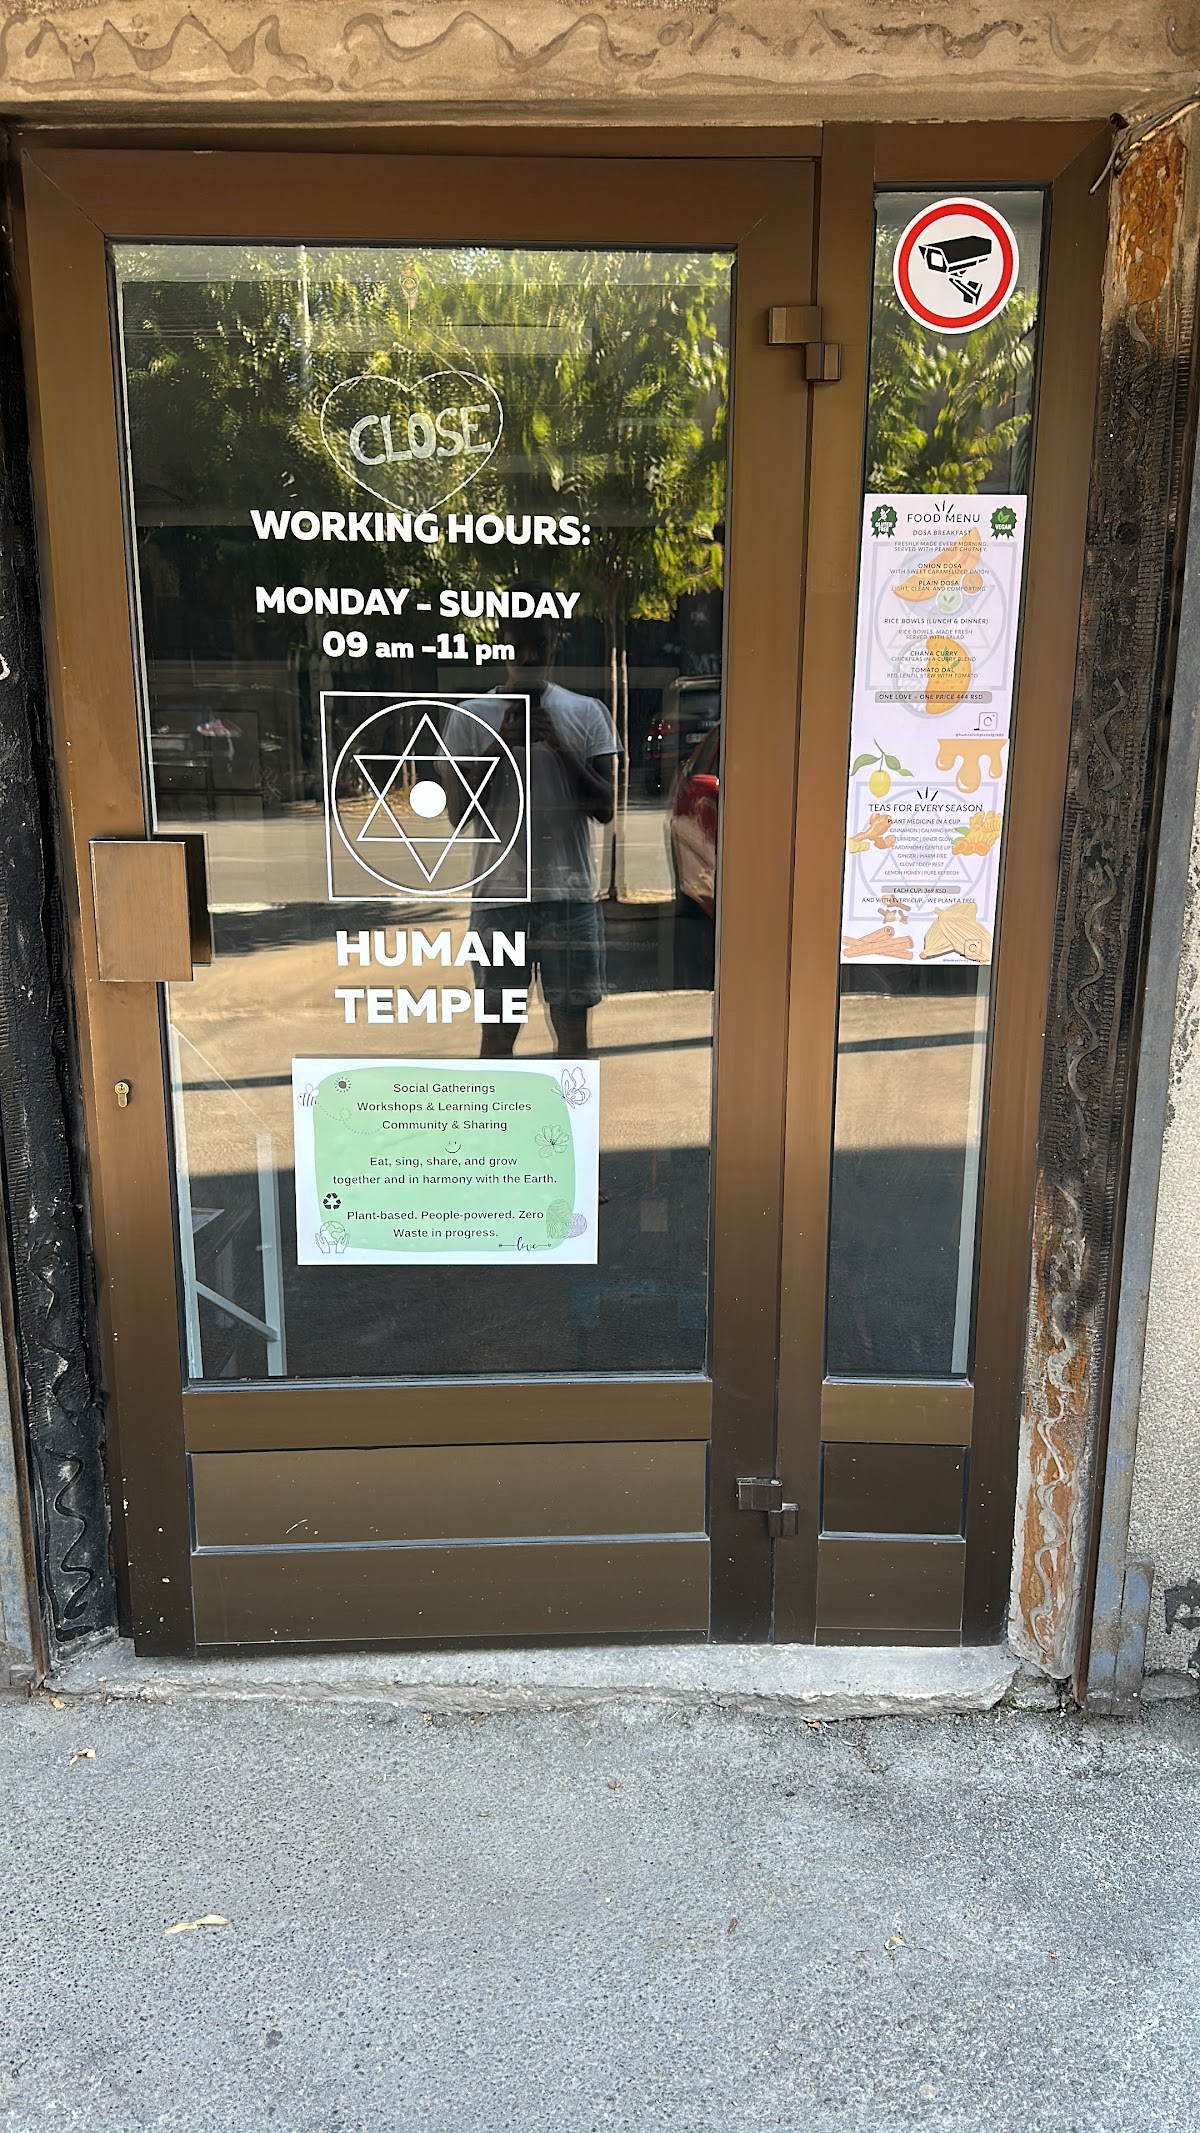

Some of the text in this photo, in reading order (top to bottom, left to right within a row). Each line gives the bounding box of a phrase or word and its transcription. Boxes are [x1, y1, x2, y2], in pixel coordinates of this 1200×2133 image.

[350, 404, 491, 466] CLOSE
[907, 513, 980, 523] FOOD MENU
[250, 509, 591, 546] WORKING HOURS:
[255, 585, 410, 616] MONDAY
[439, 589, 580, 619] SUNDAY
[322, 630, 368, 658] 09
[375, 642, 414, 659] am
[475, 643, 516, 665] pm
[869, 804, 982, 812] TEAS FOR EVERY SEASON
[336, 930, 526, 967] HUMAN
[335, 988, 528, 1024] TEMPLE
[393, 1083, 495, 1096] Social Gatherings
[357, 1102, 532, 1114] Workshops & Learning Circles
[382, 1120, 507, 1133] Community & Sharing
[370, 1156, 517, 1169] Eat, sing, share, and grow
[333, 1174, 557, 1186] together and in harmony with the Earth.
[347, 1210, 543, 1222] Plant-based. People-powered. Zero
[394, 1228, 498, 1240] Waste in progress.
[517, 1236, 538, 1251] love
